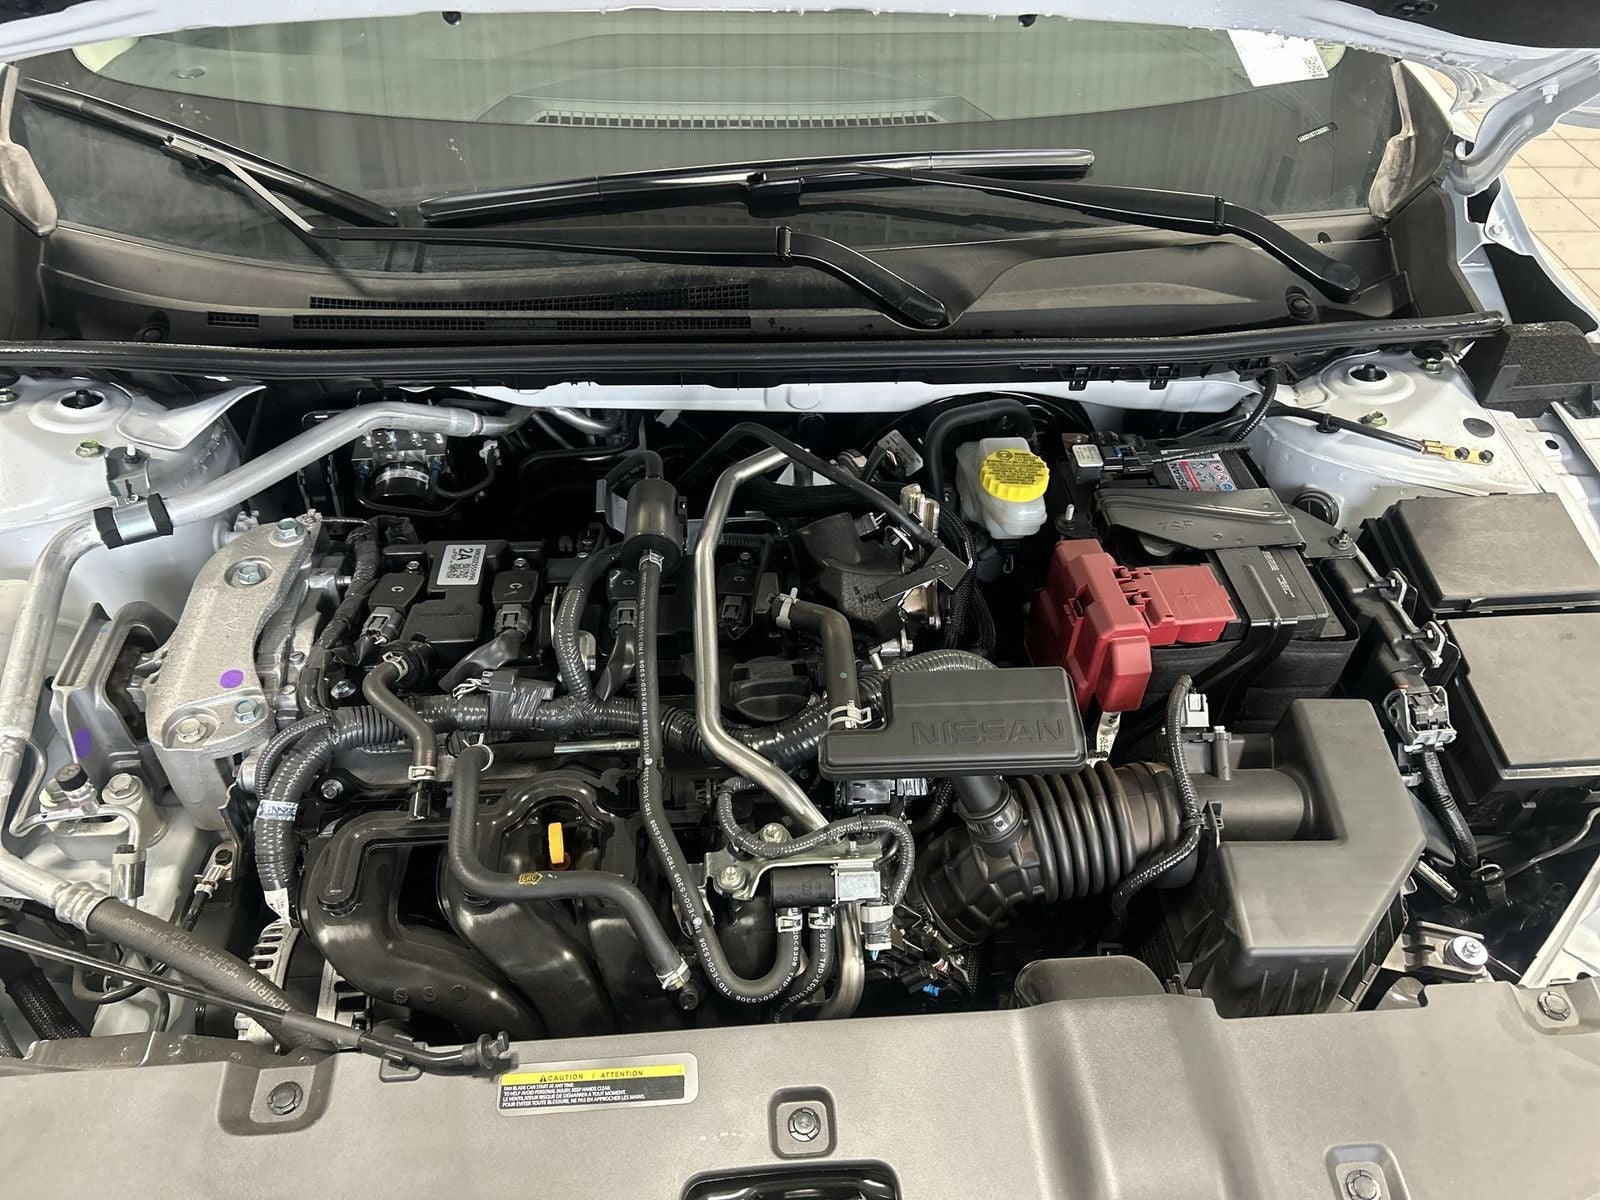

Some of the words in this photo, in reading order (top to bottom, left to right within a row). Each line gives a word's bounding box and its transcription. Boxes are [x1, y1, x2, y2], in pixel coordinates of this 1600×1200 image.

[457, 548, 474, 561] 2A
[912, 719, 1068, 745] NISSAN
[674, 872, 702, 934] TR>ECO<5308
[548, 1074, 584, 1082] CAUTION
[600, 1070, 644, 1078] ATTENTION
